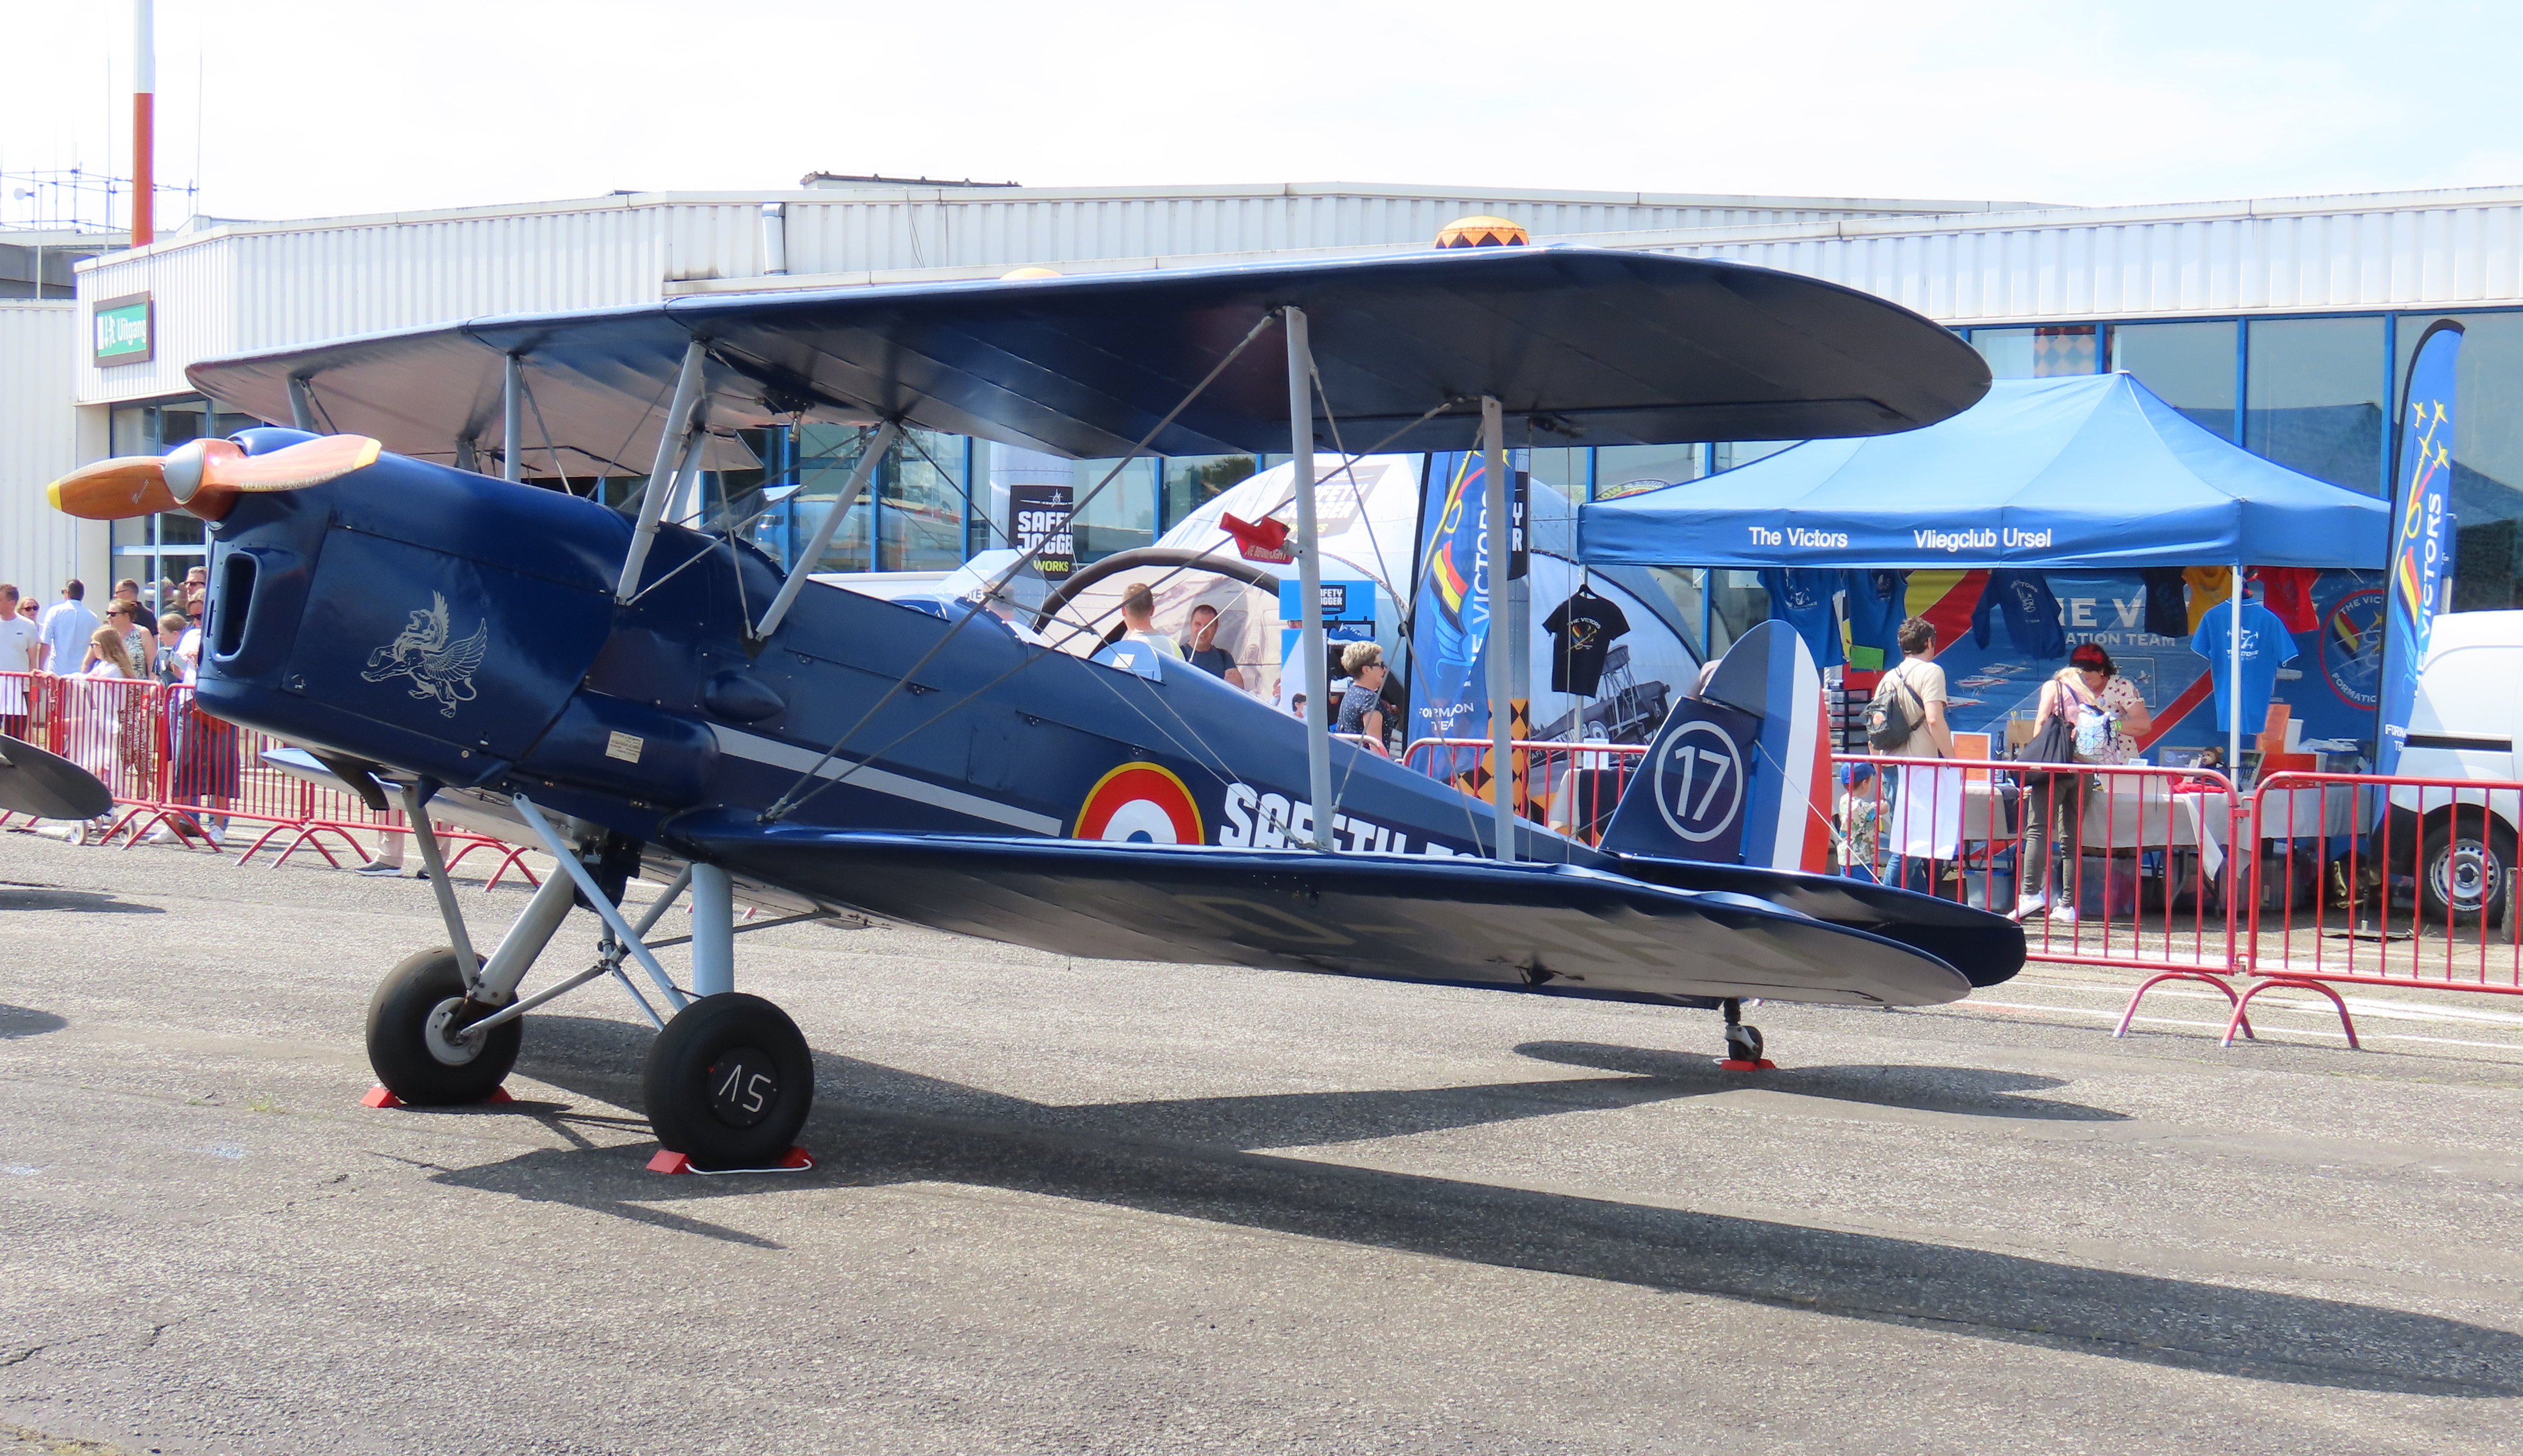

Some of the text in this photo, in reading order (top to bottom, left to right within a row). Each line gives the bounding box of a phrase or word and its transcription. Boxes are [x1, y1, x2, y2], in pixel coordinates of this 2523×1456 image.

[117, 316, 146, 346] Uitgang
[1279, 501, 1357, 519] JGER
[1749, 527, 2051, 553] The Victors Vliegclub Ursel
[1033, 560, 1069, 572] WORKS
[1473, 490, 1489, 625] VICTO
[2421, 492, 2441, 639] VICTORS
[1320, 588, 1342, 597] FETY
[1320, 597, 1343, 605] GGER
[2340, 599, 2361, 615] THE
[2065, 632, 2176, 647] ATION TEAM
[2332, 672, 2377, 703] FORMATIO
[1430, 717, 1454, 731] TEA
[1675, 746, 1731, 821] 17
